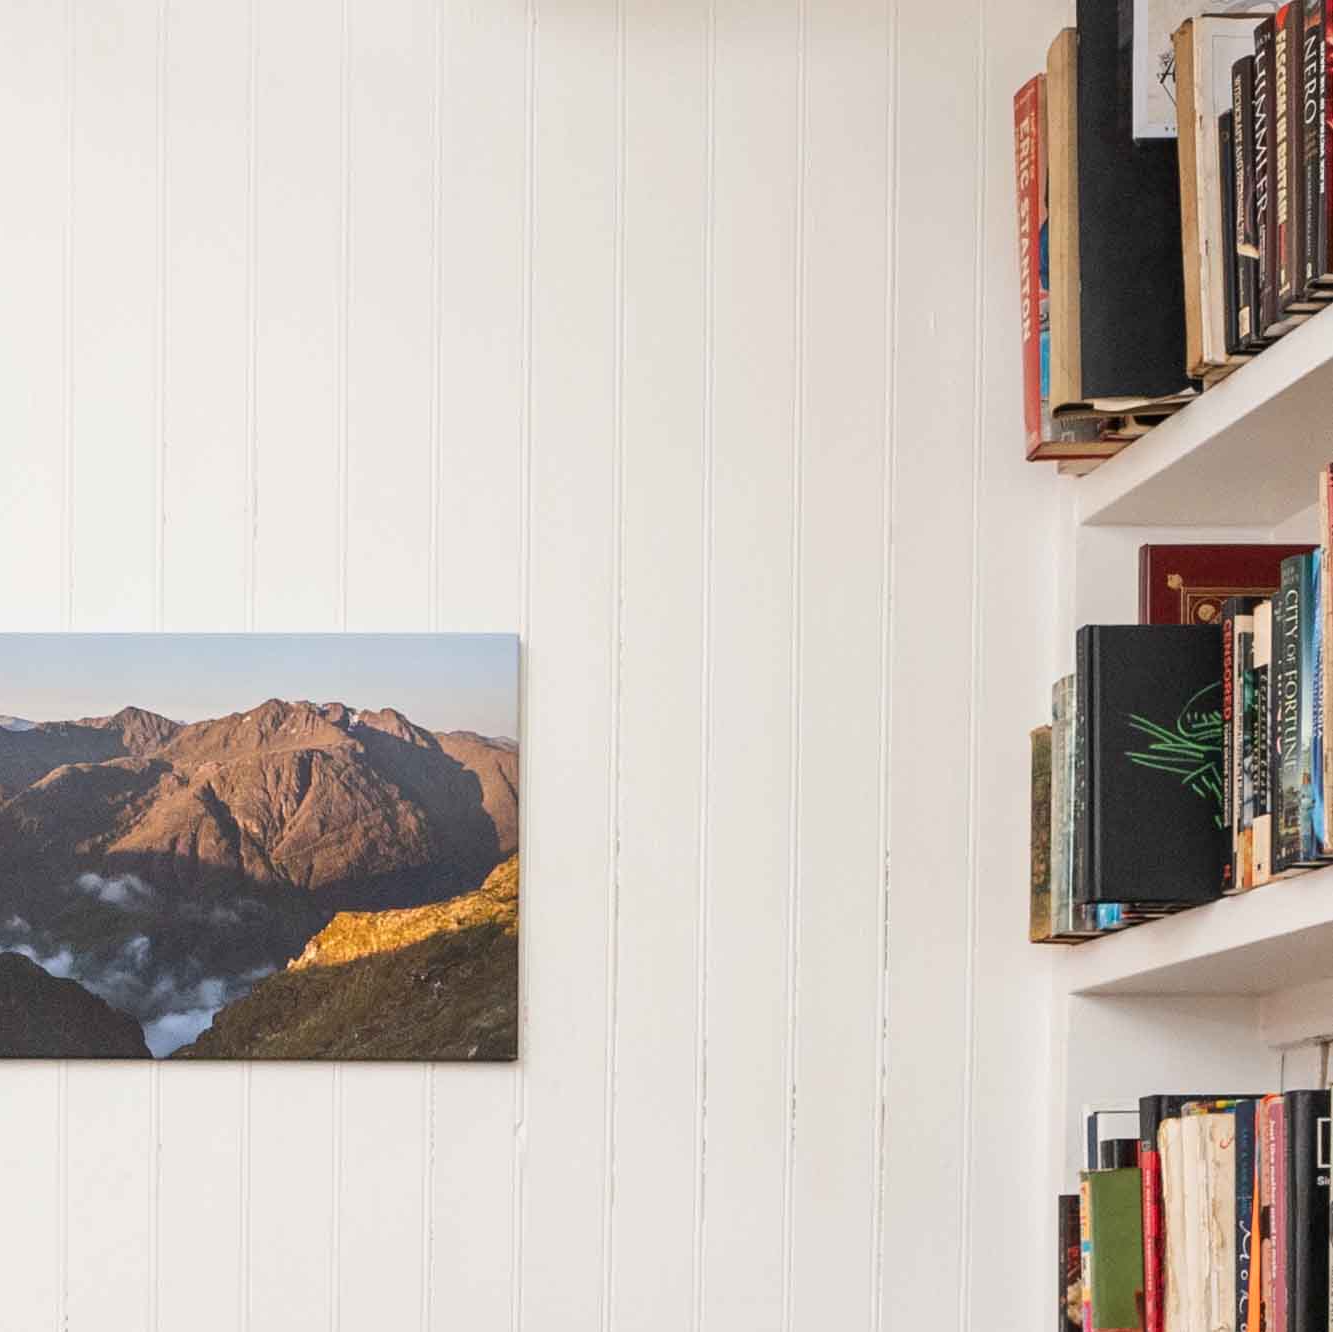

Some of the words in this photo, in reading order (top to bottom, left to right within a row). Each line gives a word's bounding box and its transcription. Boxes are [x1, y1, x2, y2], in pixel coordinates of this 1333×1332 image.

[1276, 29, 1287, 118] FASCISM
[1304, 35, 1317, 124] NERO
[1019, 116, 1031, 192] ERIC
[1254, 50, 1268, 224] HIMMLER
[1276, 117, 1287, 143] IN
[1276, 143, 1287, 225] BRITAIN
[1020, 197, 1032, 346] STANTON
[1283, 589, 1299, 638] CITY
[1285, 644, 1297, 663] OF
[1223, 618, 1233, 721] CENSORED
[1283, 669, 1299, 772] FORTUNE
